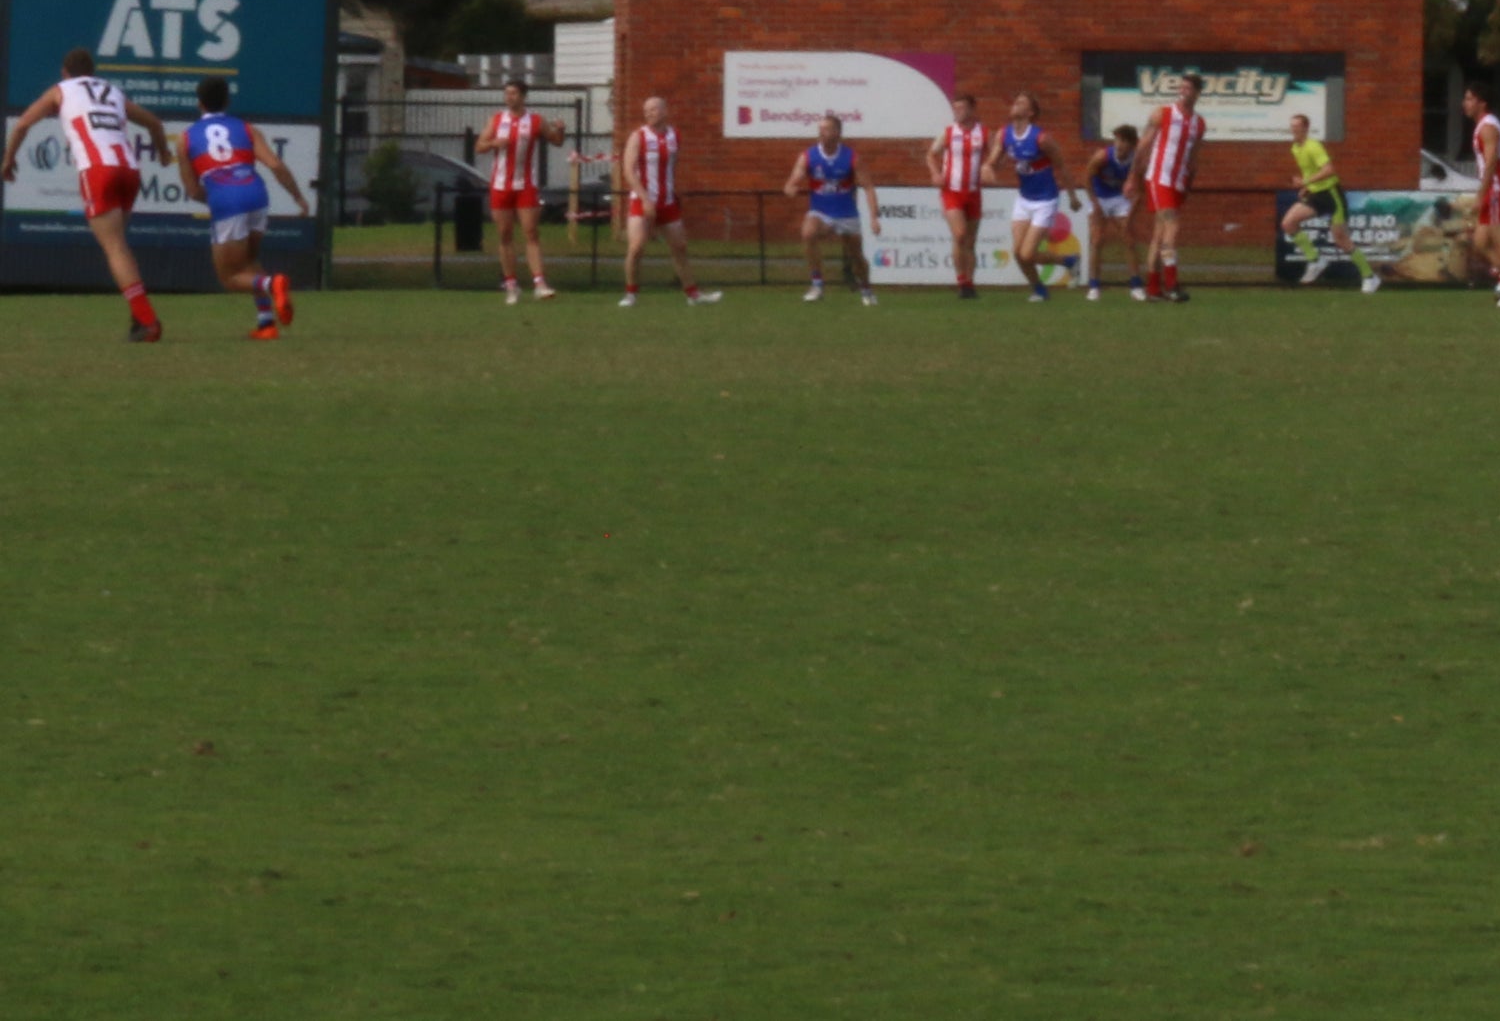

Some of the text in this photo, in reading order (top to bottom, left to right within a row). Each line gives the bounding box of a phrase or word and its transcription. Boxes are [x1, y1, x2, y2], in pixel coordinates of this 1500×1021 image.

[205, 124, 233, 162] 8
[877, 204, 916, 219] WISE
[893, 249, 939, 269] Let's
